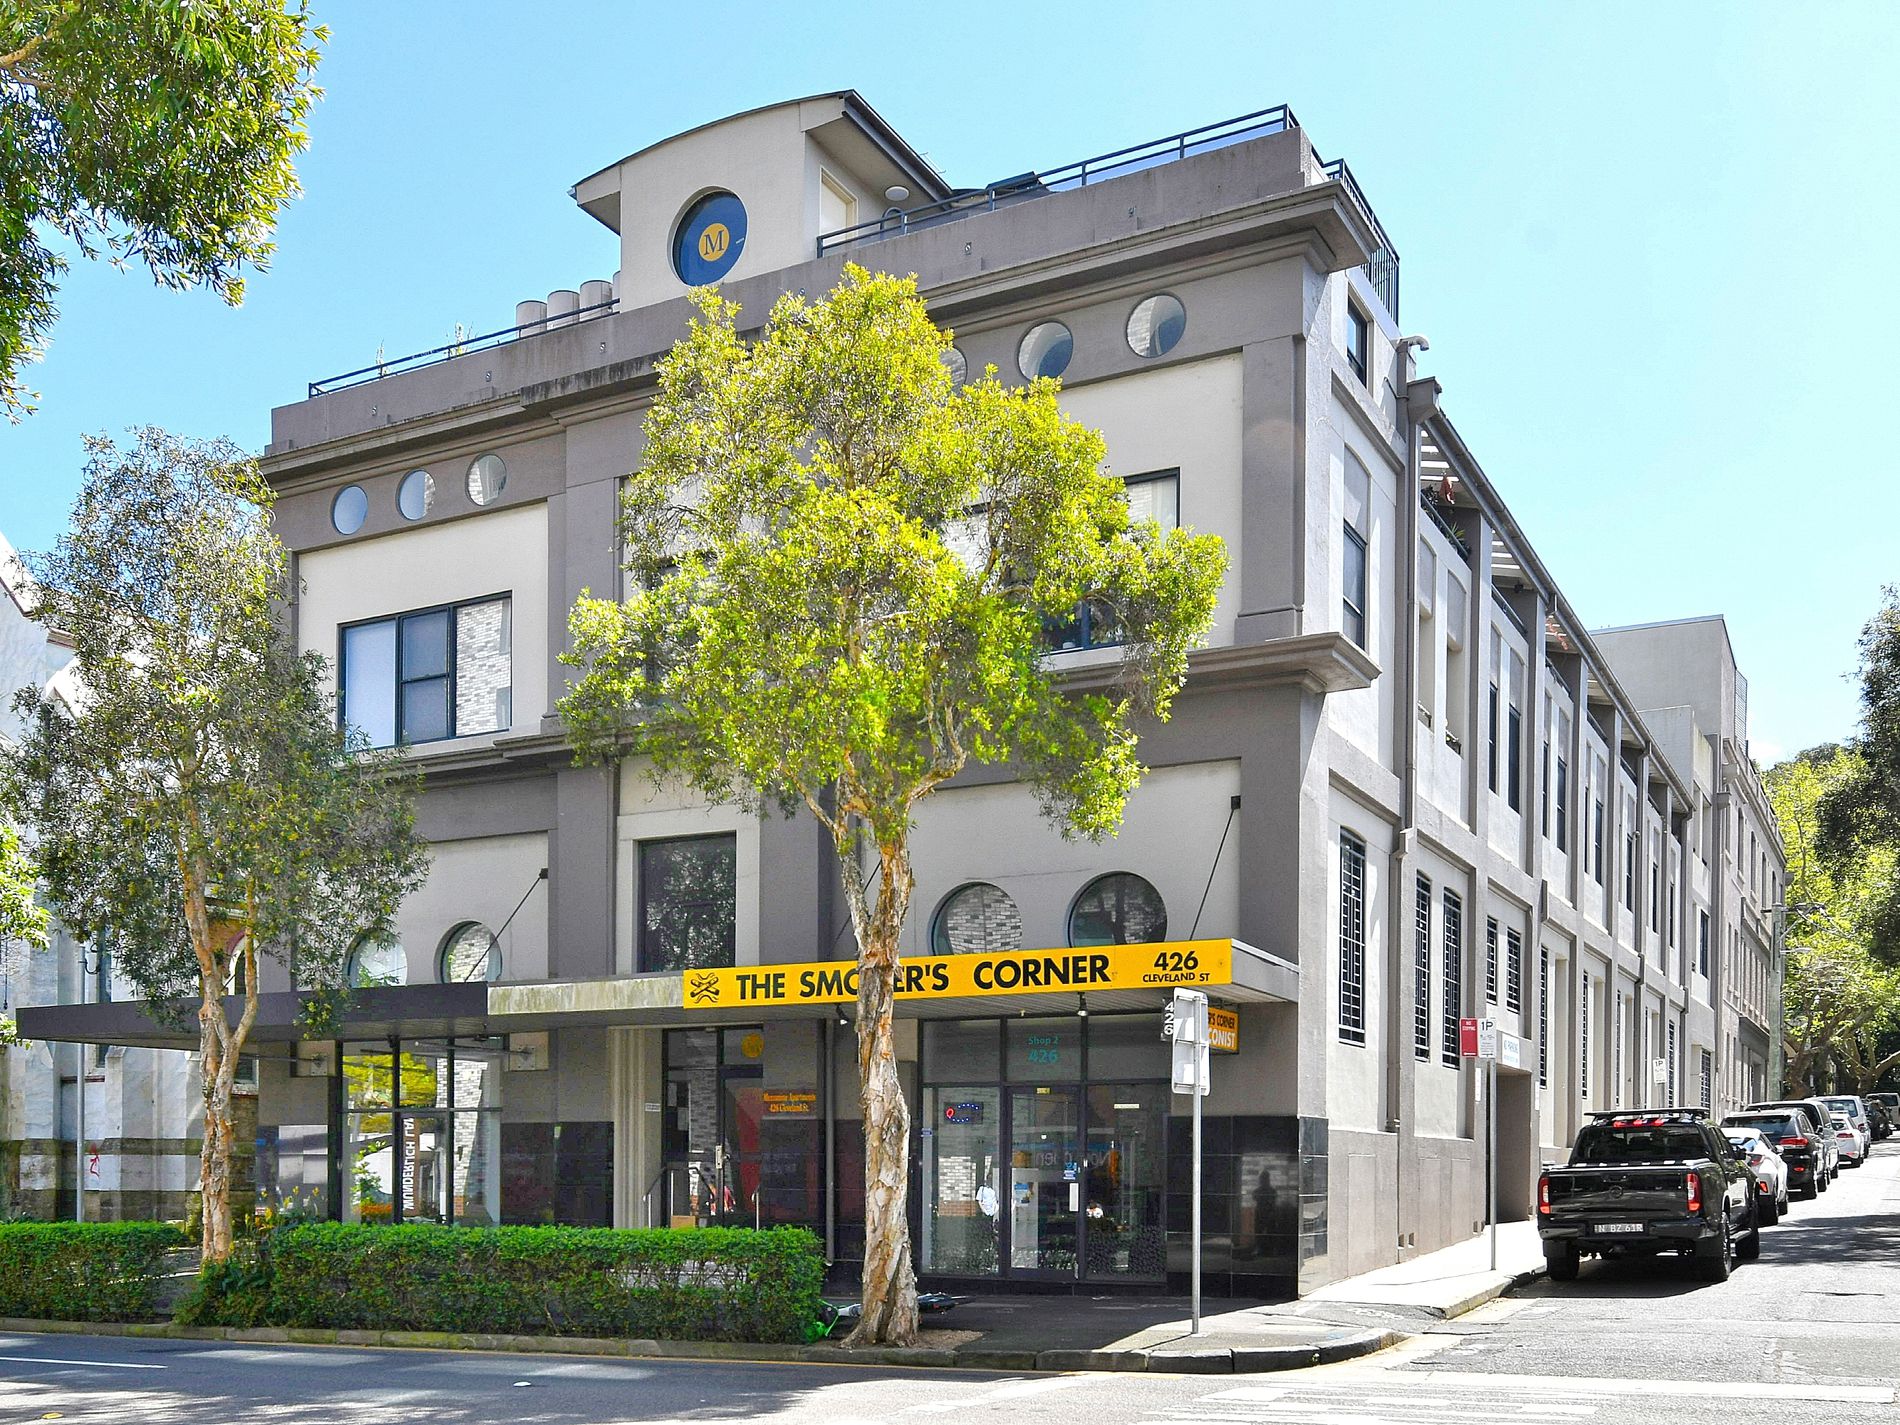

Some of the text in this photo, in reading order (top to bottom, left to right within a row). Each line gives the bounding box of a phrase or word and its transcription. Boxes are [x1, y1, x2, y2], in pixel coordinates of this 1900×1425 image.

[704, 229, 724, 256] M
[1154, 951, 1199, 971] 426
[736, 954, 1112, 1000] THE SMOER'S CORNER
[1142, 972, 1211, 983] CLEVELAND ST
[1481, 1021, 1494, 1031] 1P
